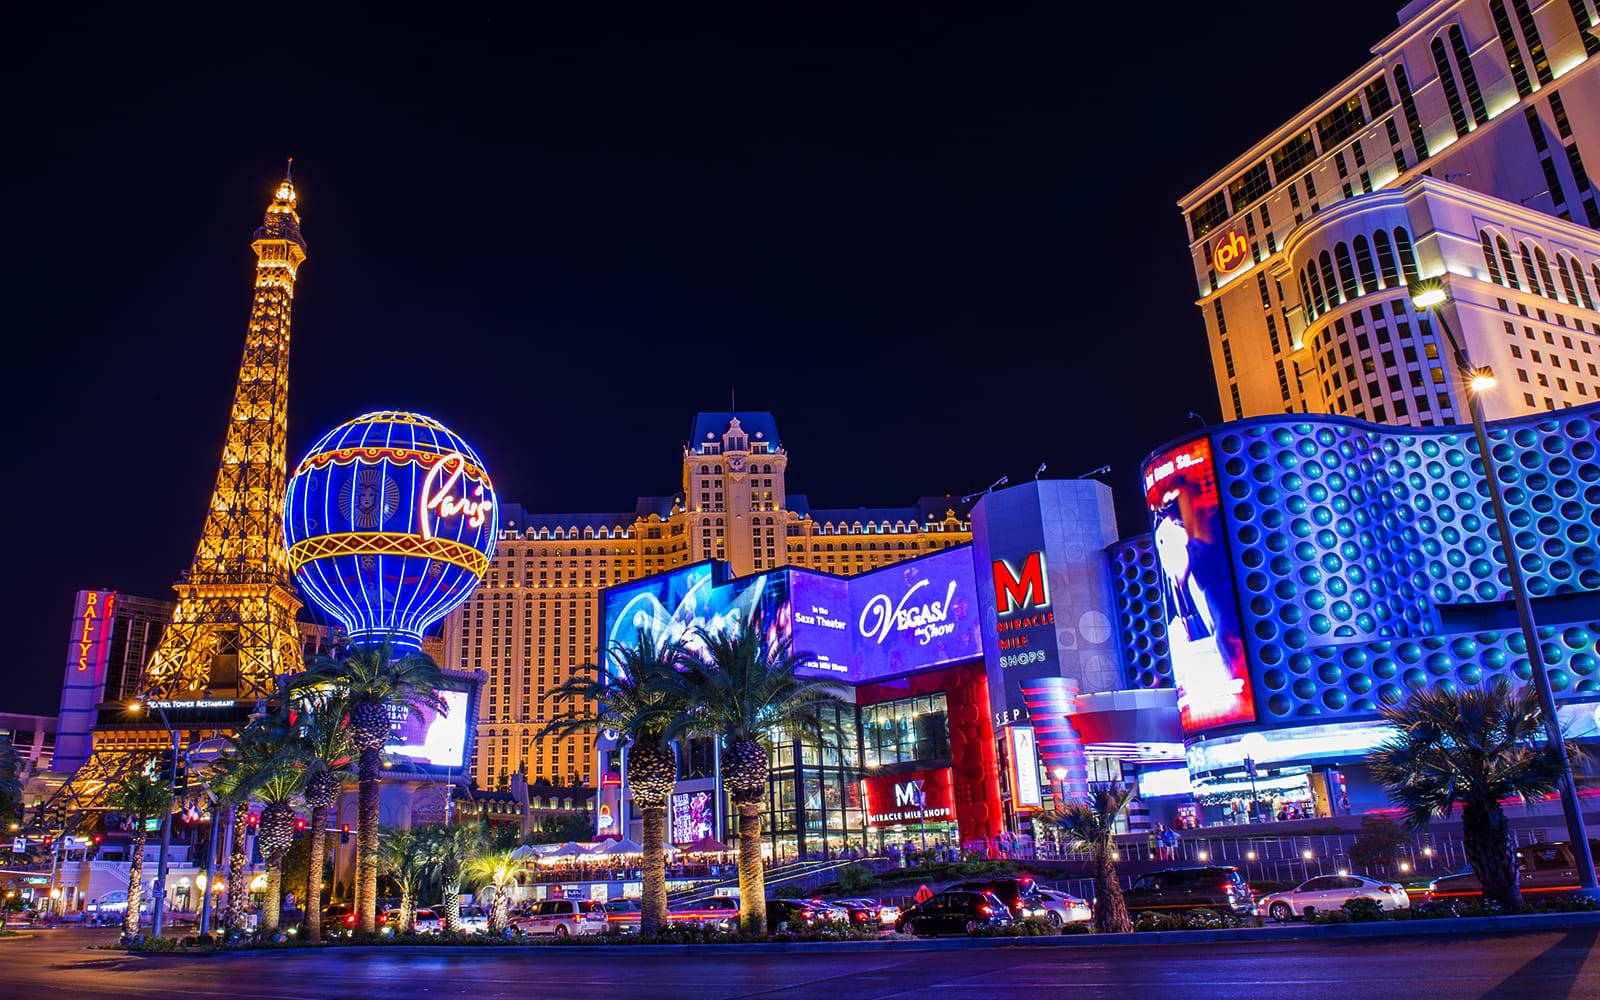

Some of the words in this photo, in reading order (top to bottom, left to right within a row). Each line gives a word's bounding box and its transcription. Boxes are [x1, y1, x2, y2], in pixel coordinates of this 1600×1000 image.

[1217, 231, 1247, 270] ph
[421, 453, 493, 541] Paris
[992, 551, 1050, 616] M
[795, 612, 815, 625] Saxe
[816, 615, 847, 630] Theater
[859, 578, 957, 645] VEGAS!
[996, 611, 1055, 632] MIRACLE
[920, 622, 955, 646] Show
[998, 635, 1028, 650] MILE
[1000, 650, 1046, 668] SHOPS
[172, 700, 195, 708] TOWER
[196, 699, 236, 708] RESTAURANT
[894, 781, 915, 807] M
[869, 812, 903, 823] MIRACLE
[904, 810, 922, 820] MILE
[923, 807, 951, 818] SHOPS
